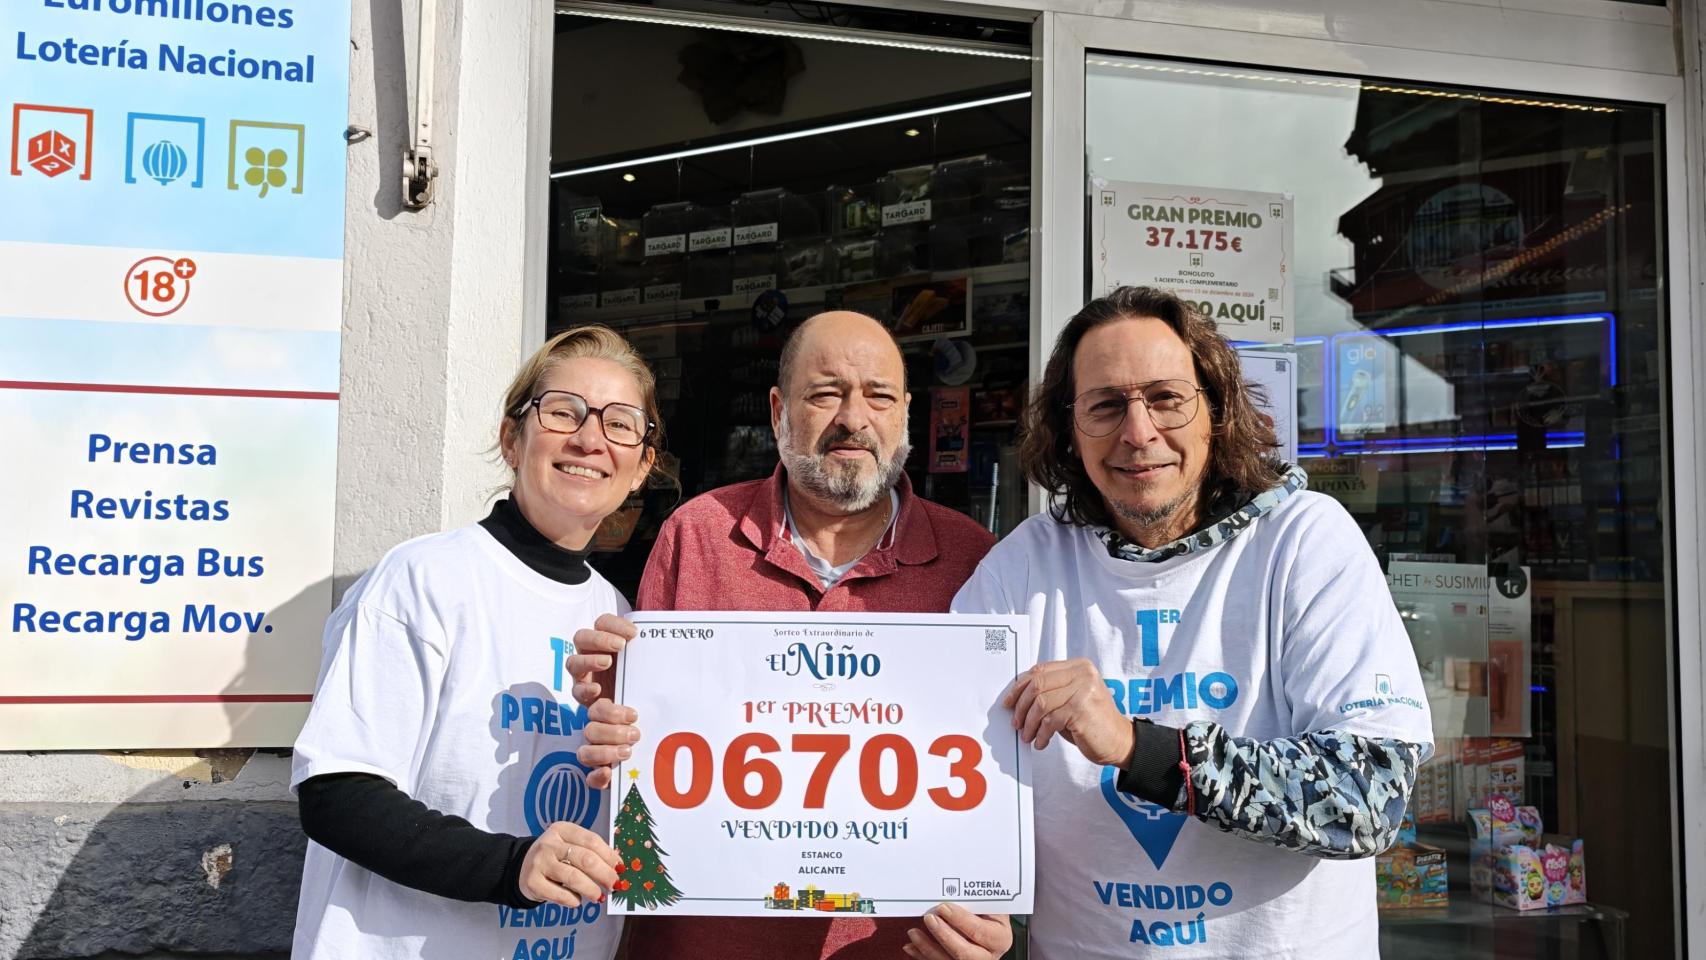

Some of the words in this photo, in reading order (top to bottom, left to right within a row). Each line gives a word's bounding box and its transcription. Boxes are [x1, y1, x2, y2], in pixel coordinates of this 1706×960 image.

[16, 31, 148, 70] Lotería
[158, 43, 315, 84] Nacional
[885, 207, 926, 220] TARGARD
[1127, 204, 1185, 224] GRAN
[1188, 208, 1263, 229] PREMIO
[647, 241, 681, 252] TARGARD
[692, 235, 727, 246] TARGARD
[735, 230, 773, 242] TARGARD
[1145, 226, 1243, 253] 37.175€
[735, 280, 772, 292] TARGARD
[1159, 277, 1185, 285] ACIERTOS
[1189, 278, 1239, 288] COMPLEMENTARIO
[1178, 270, 1215, 278] BONOLOTO
[1216, 299, 1265, 323] AQUÍ
[1347, 345, 1376, 365] glo
[88, 433, 217, 466] Prensa
[1314, 477, 1367, 491] APONÍA
[70, 489, 230, 521] Revistas
[28, 545, 185, 584] Recarga
[197, 547, 265, 577] Bus
[12, 602, 170, 641] Recarga
[182, 604, 274, 634] Mov.
[640, 629, 647, 639] 6
[649, 628, 666, 639] DE
[669, 628, 714, 639] ENERO
[773, 628, 800, 637] Sorteo
[803, 627, 863, 638] Extraordinario
[865, 629, 875, 637] de
[1136, 608, 1181, 667] 1ER
[765, 653, 787, 672] El
[785, 642, 881, 681] Niño
[1104, 671, 1239, 716] REMIO
[1339, 697, 1385, 714] LOTERÍA
[501, 694, 590, 736] PREM
[742, 699, 777, 724] 1er
[782, 698, 904, 727] PREMIO
[652, 732, 988, 811] 06703
[721, 820, 838, 840] VENDIDO
[842, 817, 908, 845] AQUÍ
[801, 850, 843, 860] ESTANCO
[798, 865, 846, 875] ALICANTE
[963, 879, 1002, 889] LOTERÍA
[963, 887, 1012, 898] NACIONAL
[1093, 880, 1233, 910] VENDIDO
[498, 902, 601, 929] VENDIDO
[1128, 913, 1208, 946] AQUÍ
[512, 928, 577, 960] AQUÍ
